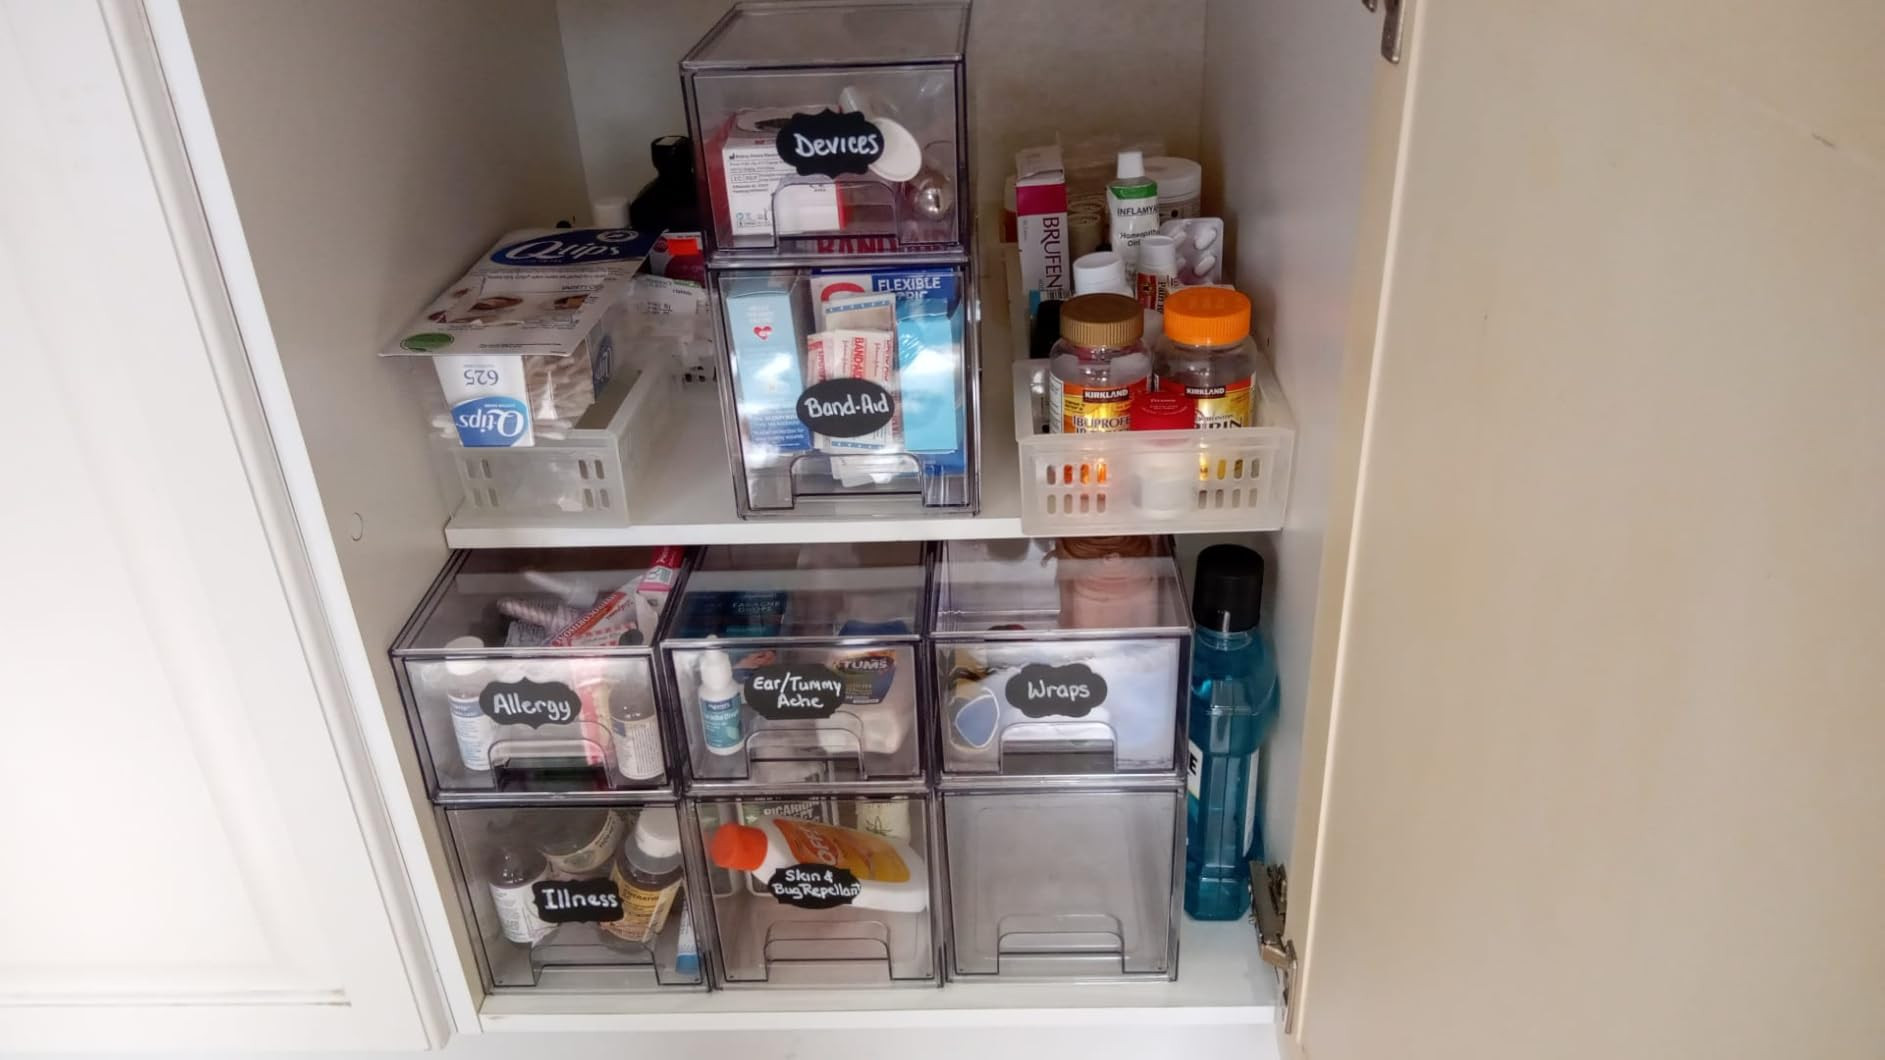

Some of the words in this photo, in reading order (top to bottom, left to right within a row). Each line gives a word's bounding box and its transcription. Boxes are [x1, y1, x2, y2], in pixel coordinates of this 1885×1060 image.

[793, 132, 880, 158] Devices
[1040, 216, 1062, 289] BRUFEN
[877, 276, 942, 292] FLEXIBLE
[463, 369, 499, 386] 625
[1084, 389, 1129, 399] KIRKLAND
[1185, 387, 1225, 396] KIRKLAND
[804, 393, 890, 418] Band-Aid
[459, 408, 525, 437] Q-tips
[843, 658, 888, 670] TUMS
[753, 672, 842, 695] Ear/Tummy
[1026, 680, 1091, 701] Wraps
[492, 693, 572, 721] Allergy
[777, 694, 825, 709] Ache
[785, 869, 821, 882] Skin
[823, 869, 834, 883] &
[541, 888, 618, 910] Illness
